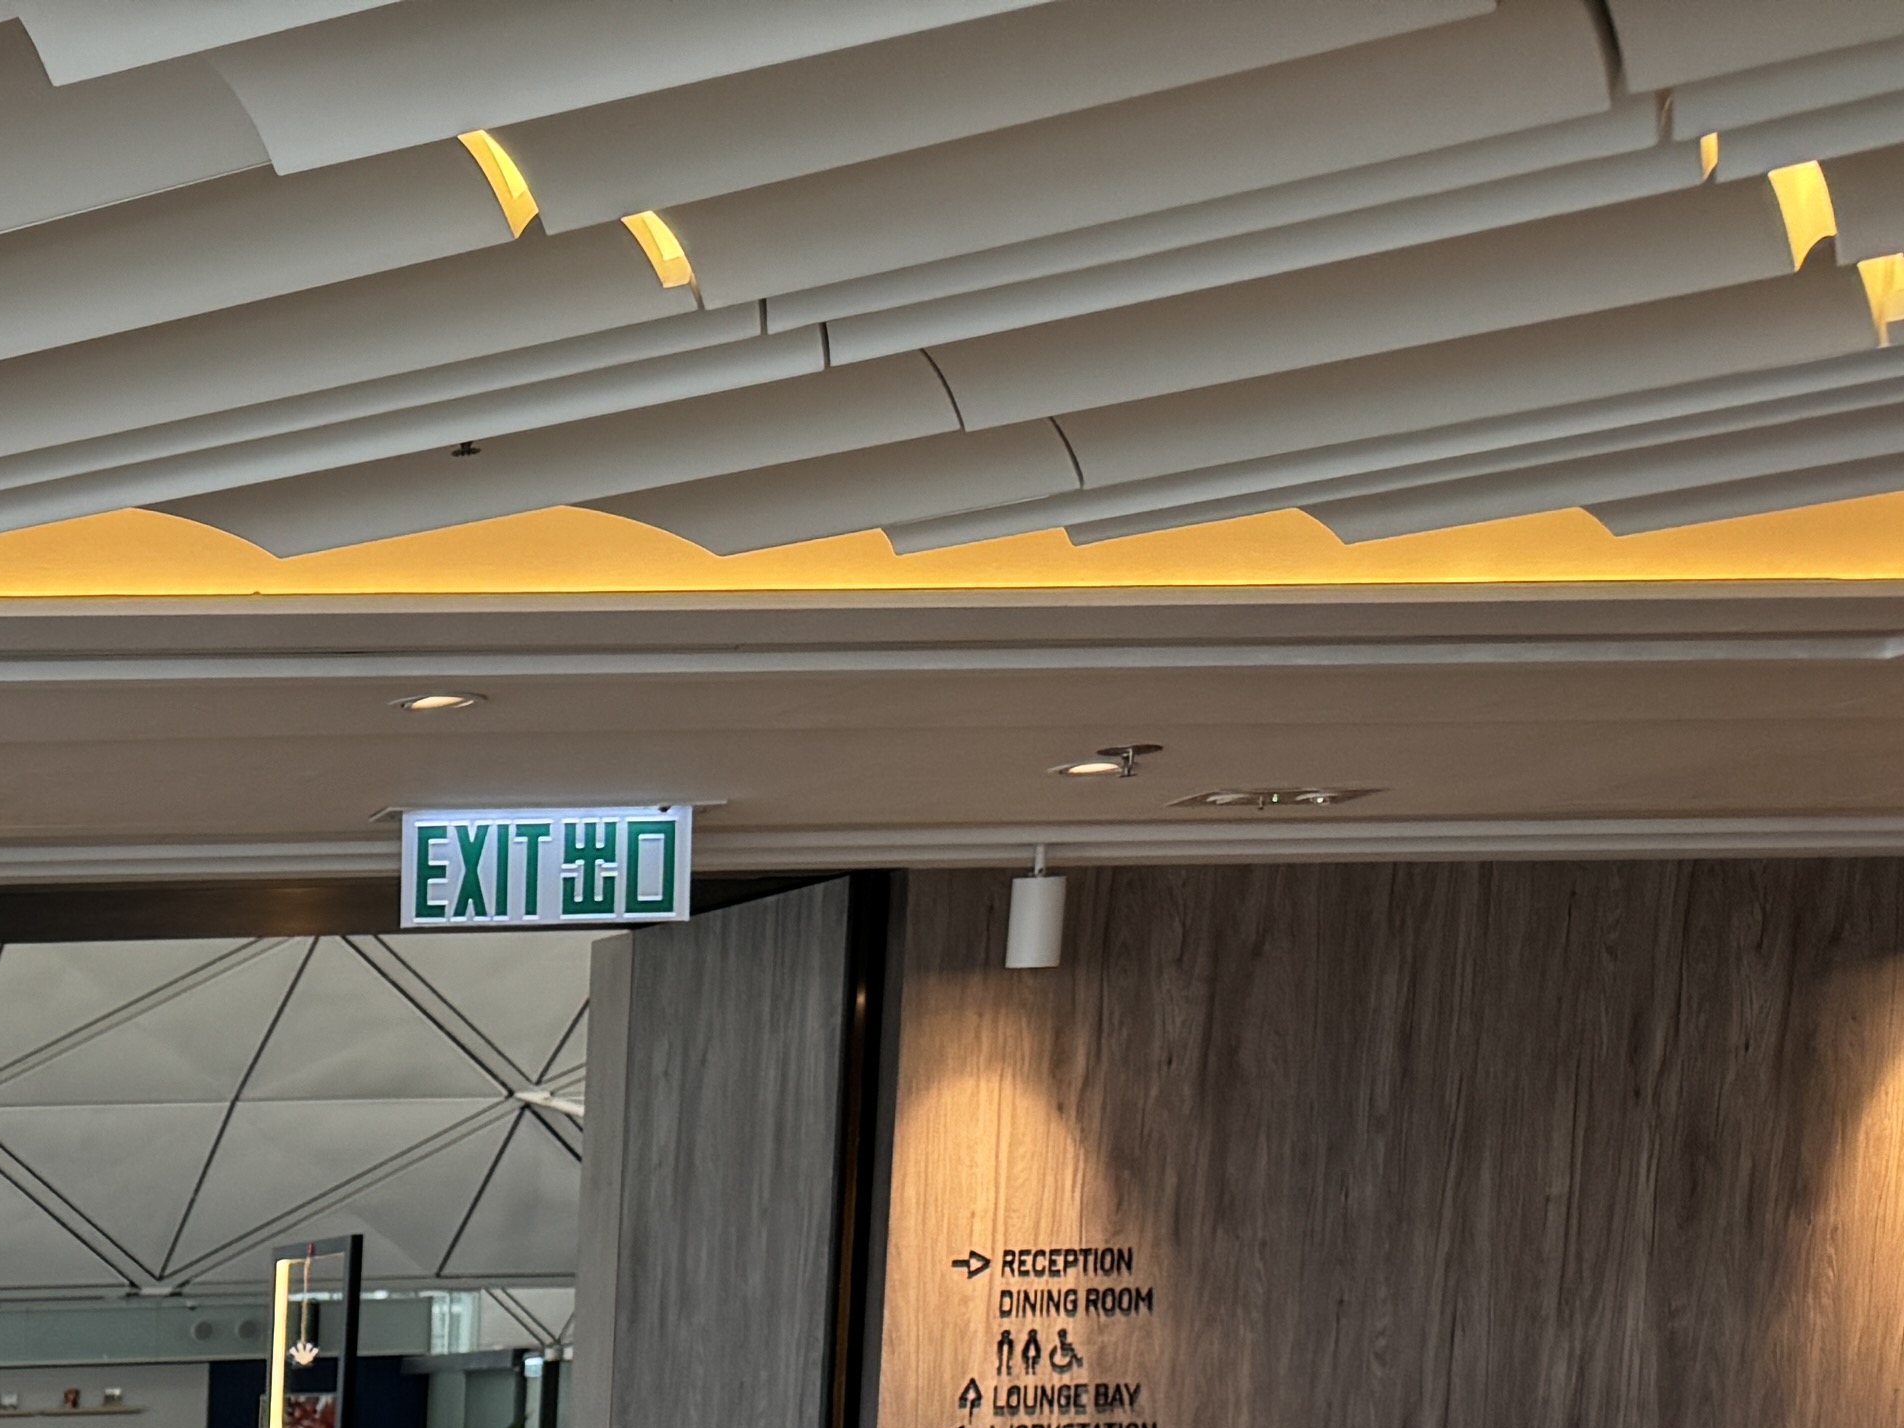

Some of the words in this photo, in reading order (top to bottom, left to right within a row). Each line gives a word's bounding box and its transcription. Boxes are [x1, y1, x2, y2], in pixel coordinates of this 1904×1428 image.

[413, 818, 553, 923] EXIT
[560, 816, 679, 920] 出口
[1000, 1246, 1134, 1279] RECEPTION
[998, 1288, 1079, 1319] DINING
[1084, 1286, 1155, 1317] ROOM
[992, 1383, 1089, 1417] LOUNGE
[1093, 1382, 1142, 1414] BAY
